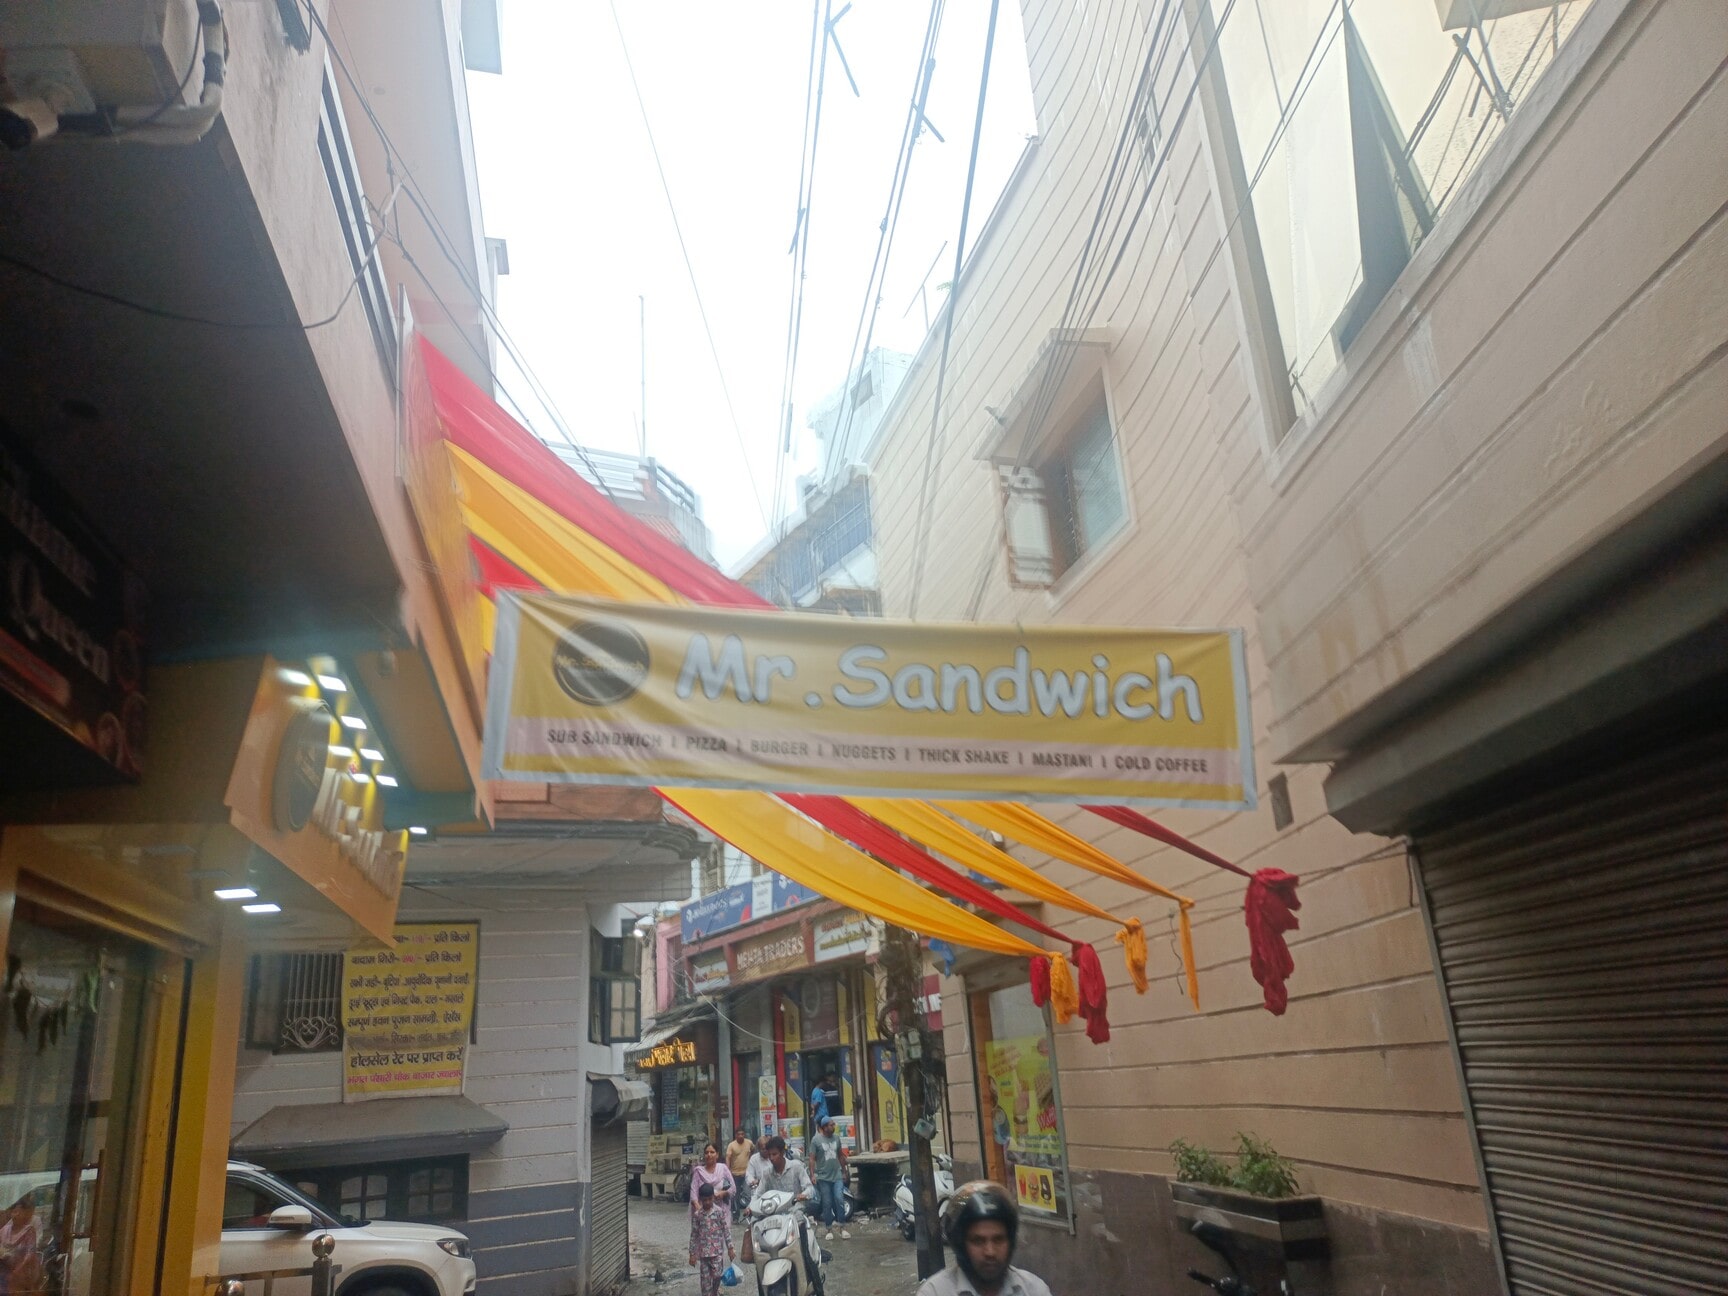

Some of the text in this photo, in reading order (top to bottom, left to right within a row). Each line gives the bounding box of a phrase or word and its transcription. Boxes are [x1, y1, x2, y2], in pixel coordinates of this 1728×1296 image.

[831, 643, 1205, 725] Sandwich
[547, 728, 1208, 773] SUB SANDWICH PIZZA BURGER NUGGETS THICK SHAKE MASTANI COLD COFFEE
[763, 935, 805, 962] TRADERS
[351, 1051, 389, 1068] होलसेल
[392, 1051, 404, 1064] रेट
[407, 1053, 419, 1064] पर
[422, 1051, 443, 1064] प्राप्त
